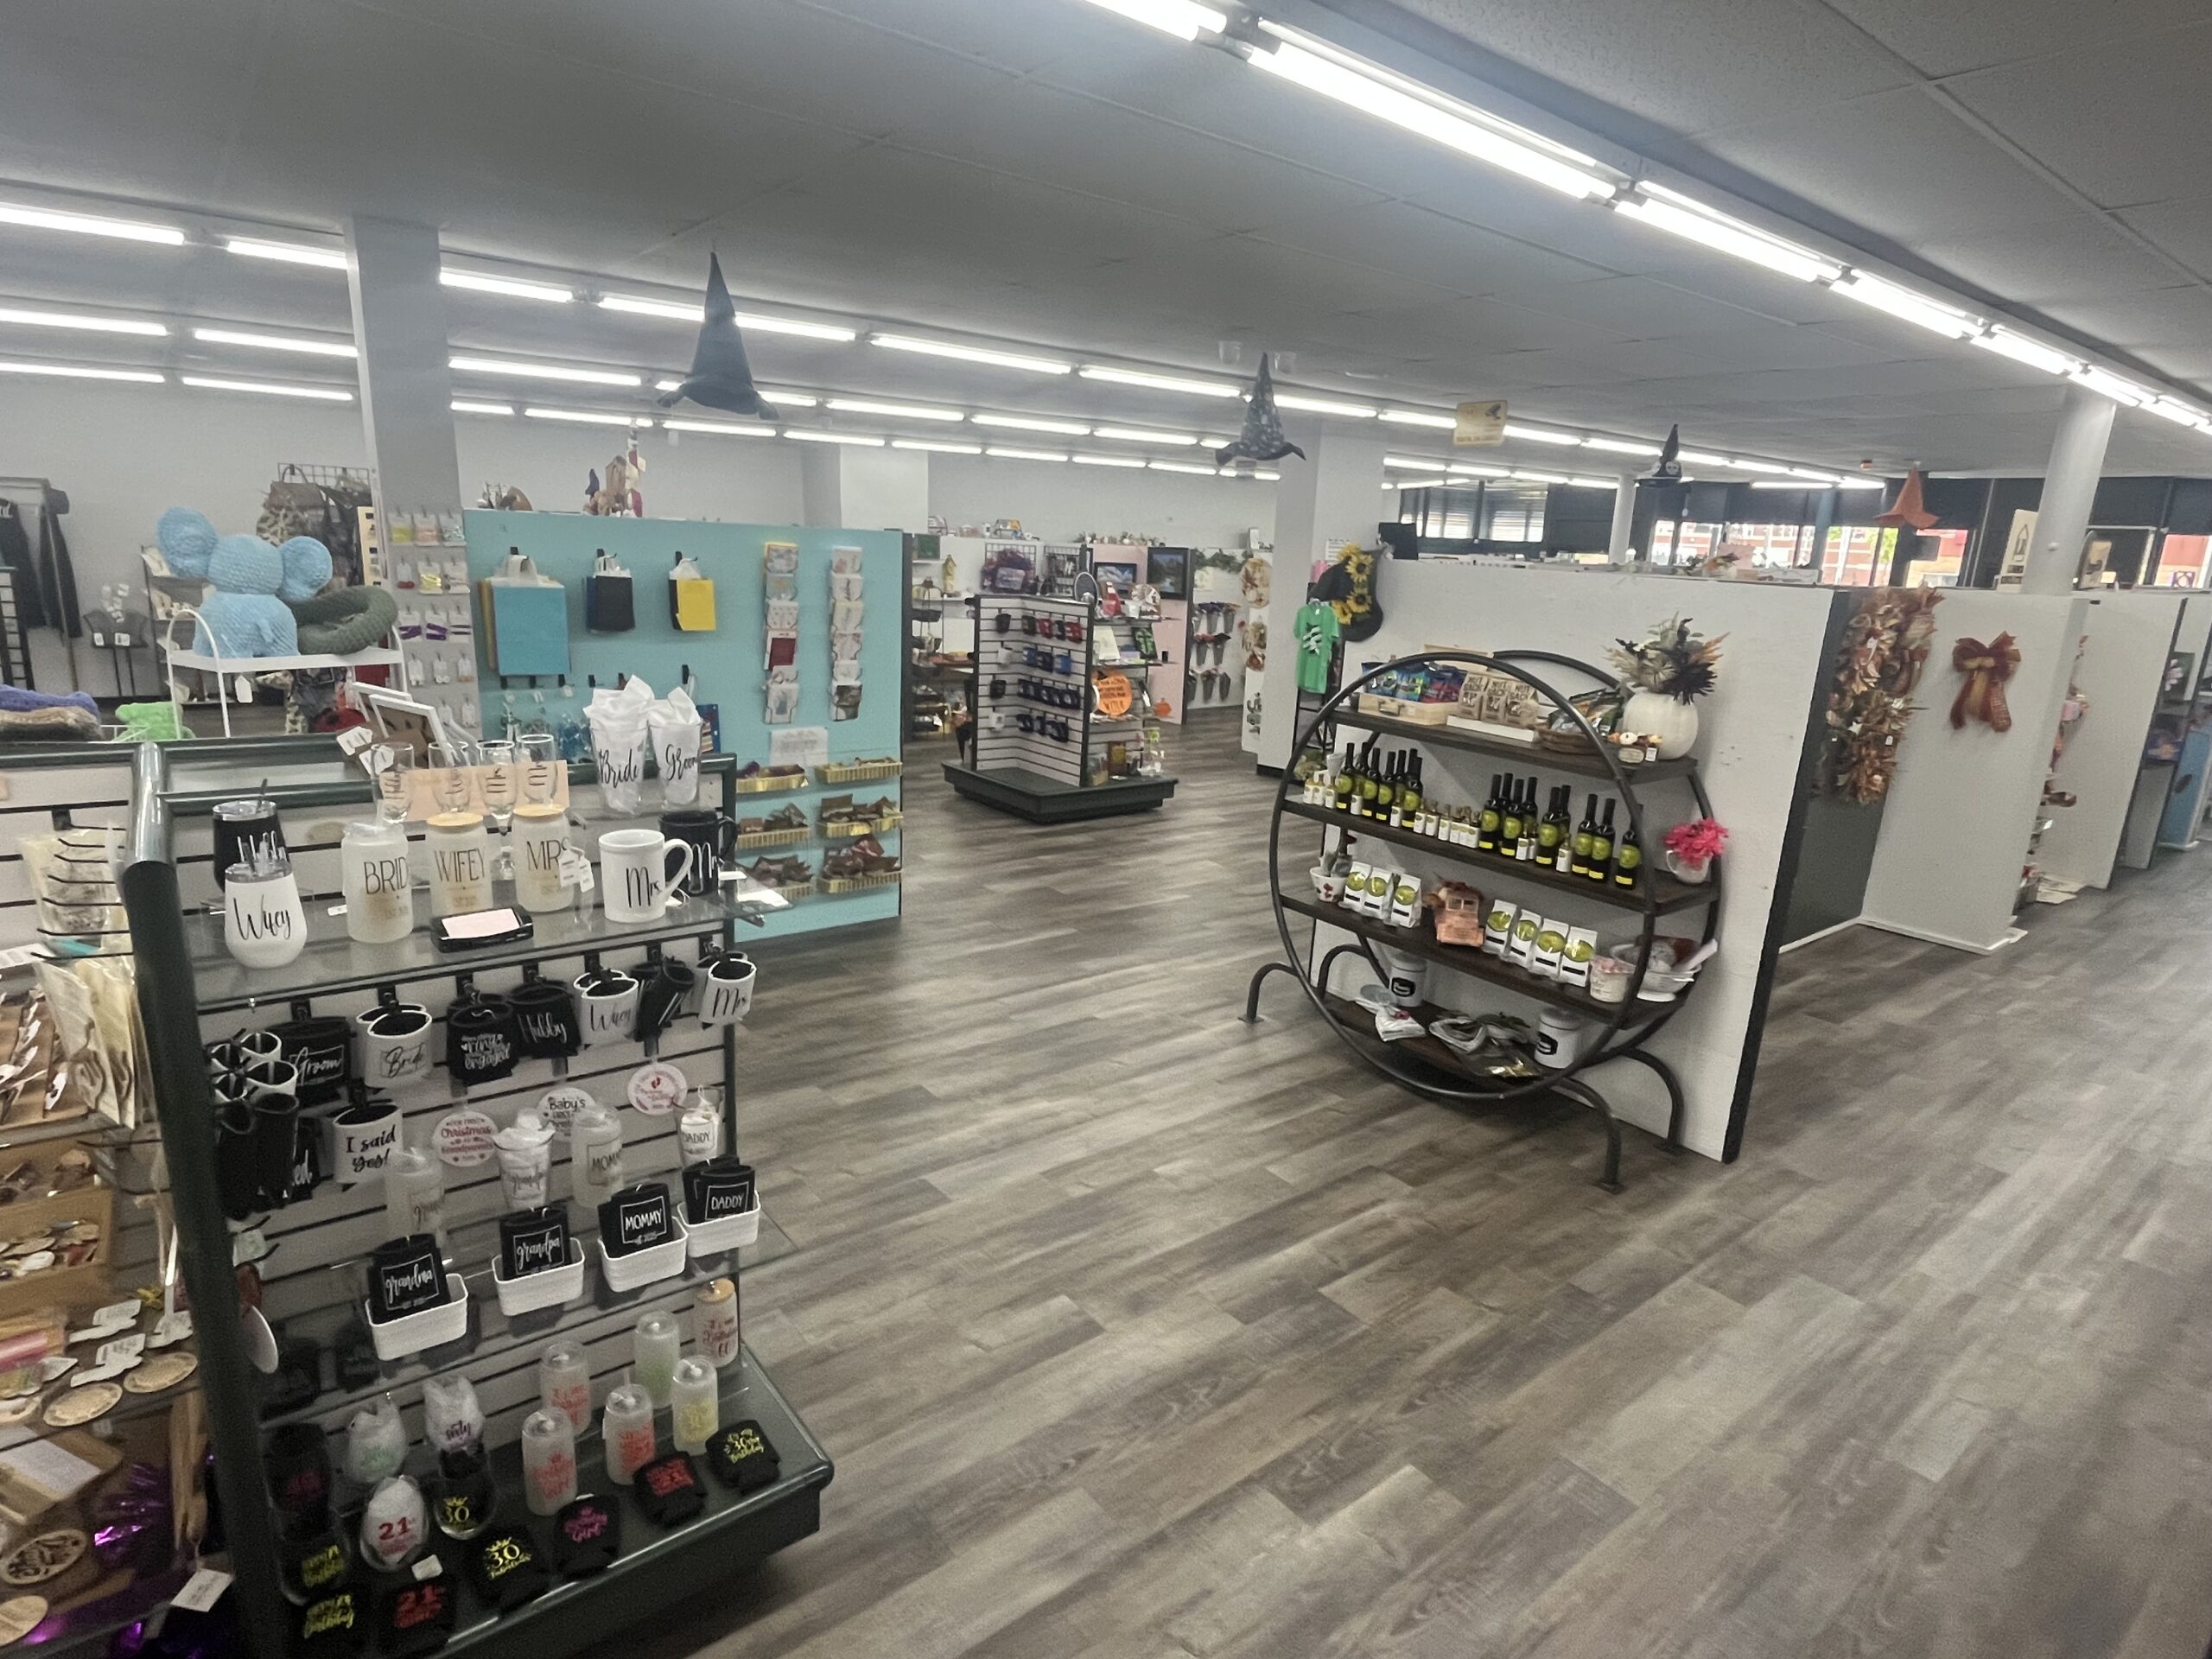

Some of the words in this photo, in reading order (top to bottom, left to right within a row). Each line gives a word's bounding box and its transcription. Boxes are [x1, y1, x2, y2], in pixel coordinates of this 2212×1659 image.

[363, 855, 409, 895] BRID
[549, 1097, 587, 1113] Baby's
[346, 1136, 355, 1154] I
[360, 1124, 397, 1153] said
[710, 1194, 745, 1211] DADDY
[625, 1208, 663, 1231] MOMMY
[516, 1232, 561, 1270] grandpa
[385, 1263, 434, 1305] grandma
[378, 1516, 409, 1541] 21
[488, 1543, 520, 1569] 30
